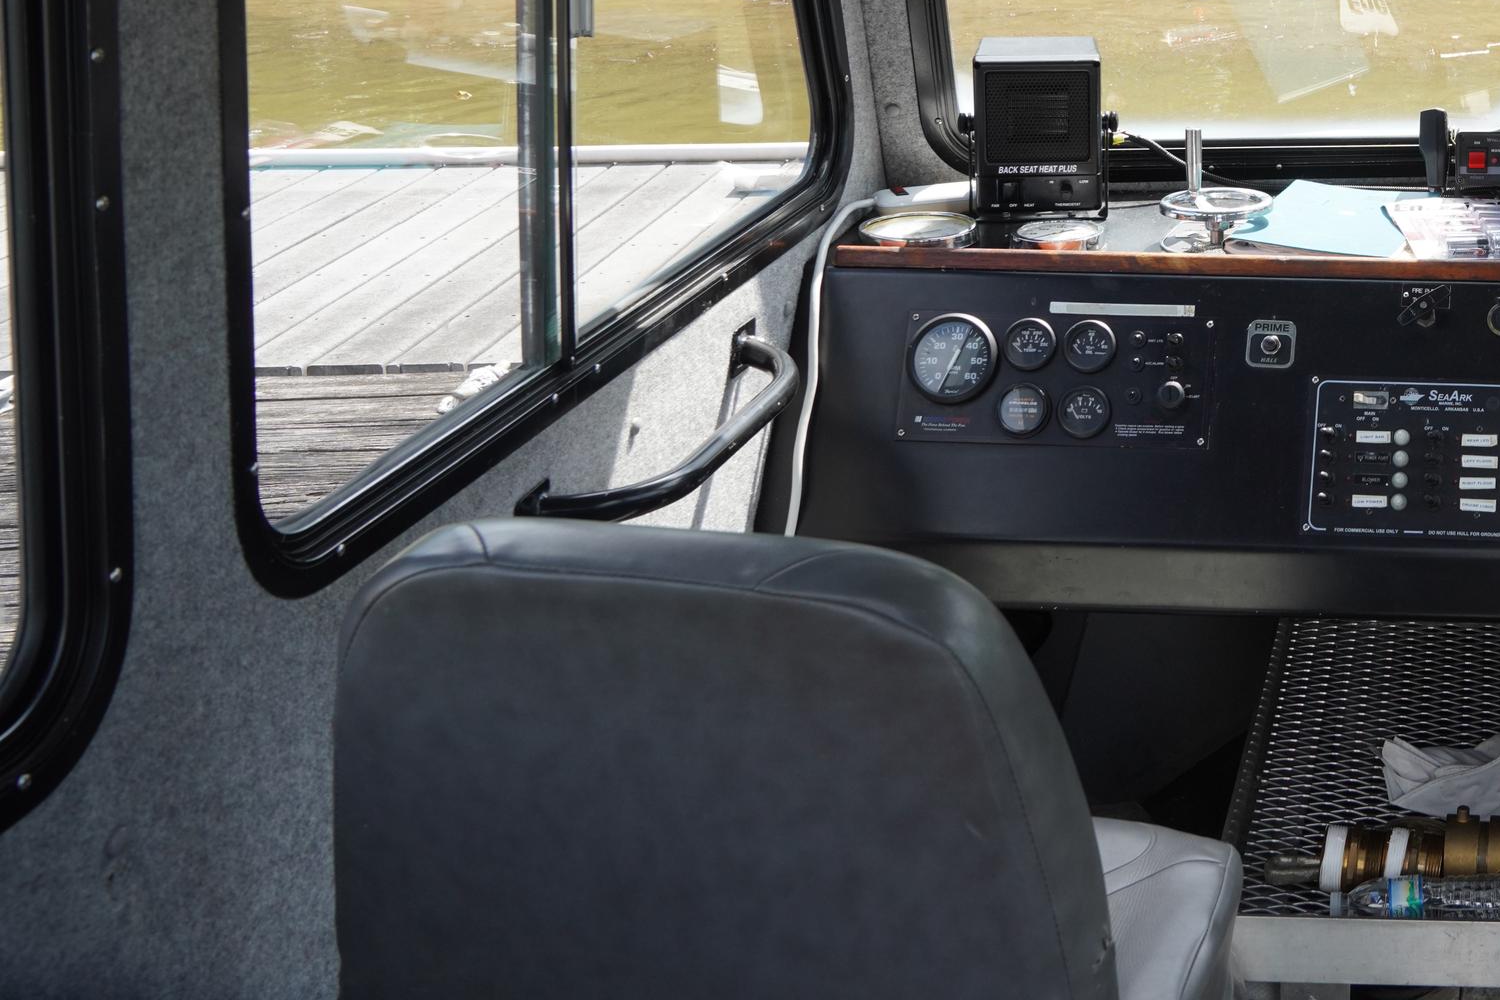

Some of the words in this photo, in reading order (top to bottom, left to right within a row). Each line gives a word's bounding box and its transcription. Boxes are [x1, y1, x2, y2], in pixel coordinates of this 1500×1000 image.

[998, 165, 1019, 174] BACK
[1019, 165, 1038, 173] SEAT
[1039, 165, 1058, 173] HEAT
[1058, 164, 1078, 172] PLUS
[1254, 323, 1290, 332] PRIME
[951, 333, 964, 341] 30
[934, 342, 946, 350] 20
[966, 342, 979, 350] 40
[926, 357, 938, 365] 10
[970, 357, 983, 365] 50
[934, 372, 942, 380] 0
[964, 372, 977, 380] 60
